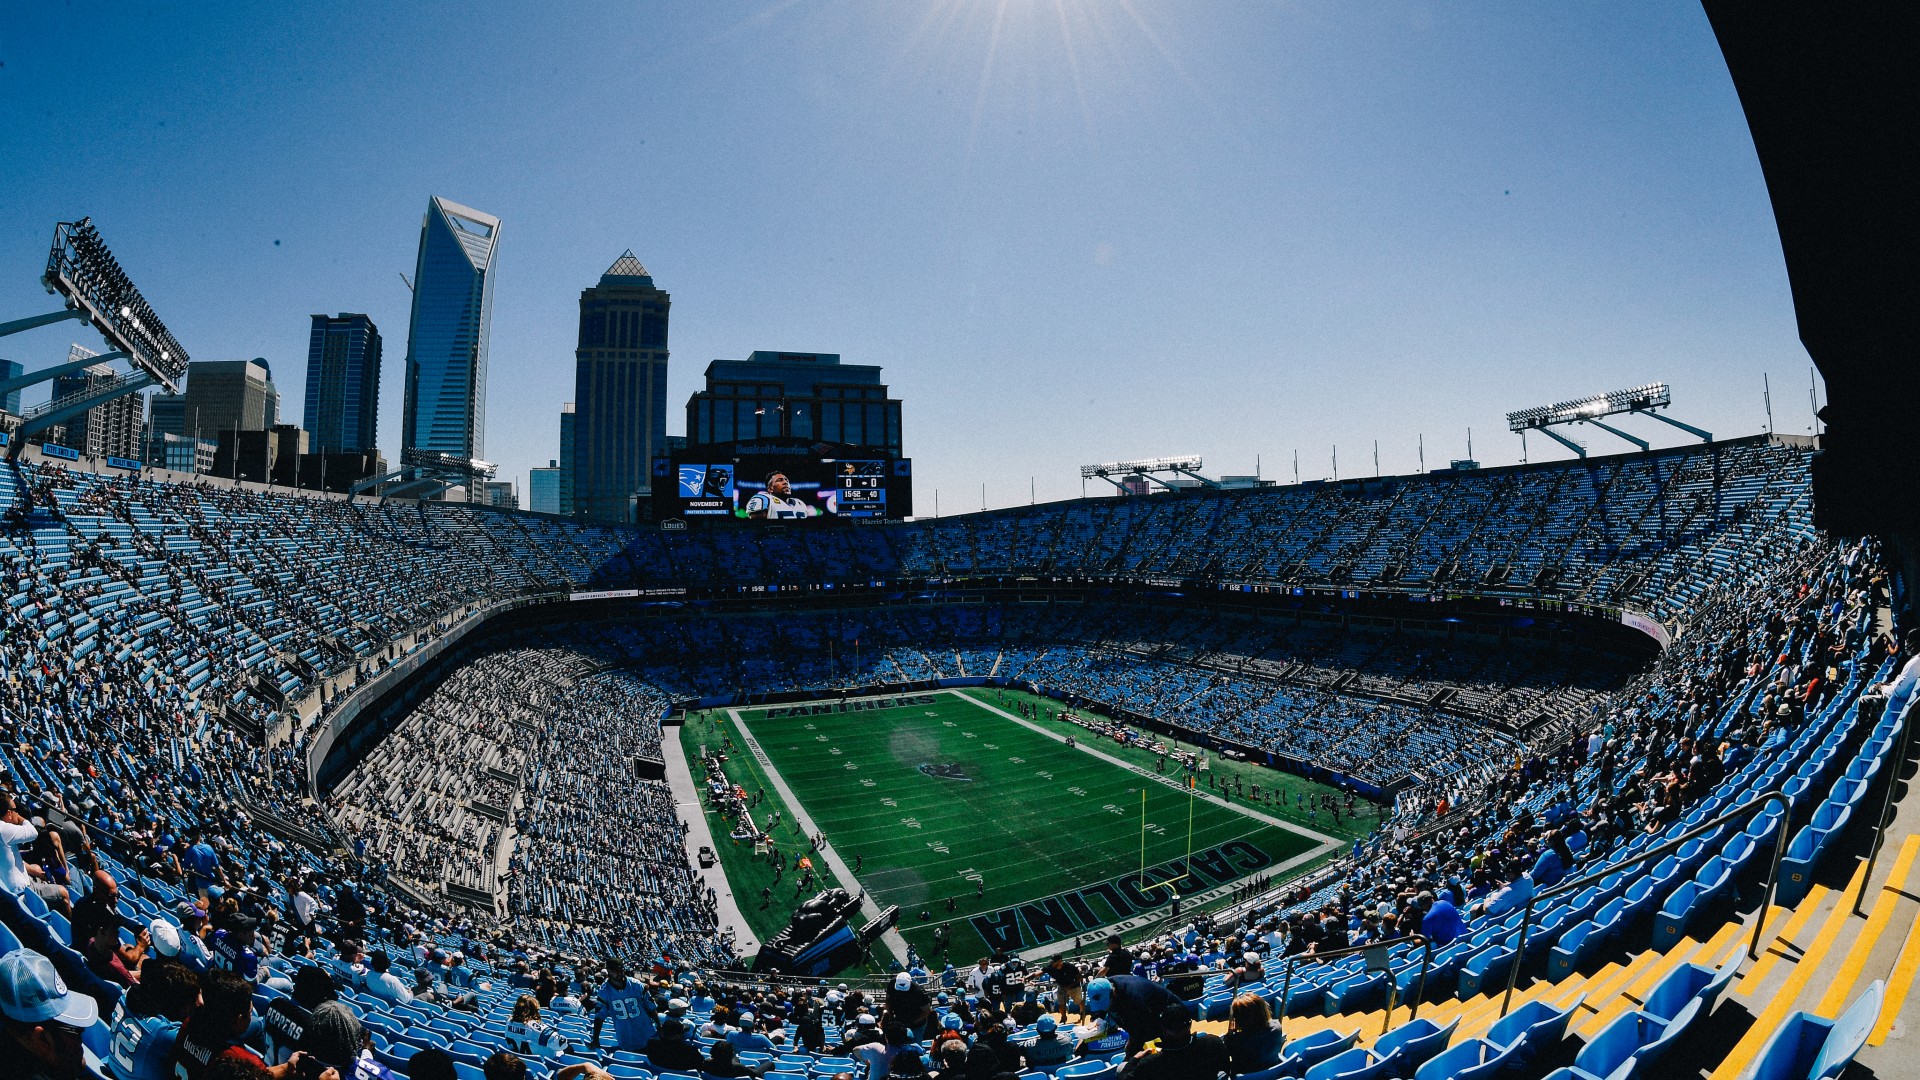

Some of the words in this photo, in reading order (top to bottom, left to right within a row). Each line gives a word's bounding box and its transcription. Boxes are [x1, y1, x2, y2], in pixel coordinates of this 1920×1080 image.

[766, 695, 937, 719] PANTHERS
[957, 867, 982, 881] 10
[1229, 881, 1245, 891] IT
[968, 841, 1271, 955] CAROLINA
[1081, 931, 1108, 943] US
[1113, 921, 1136, 934] OF
[215, 937, 237, 960] SKAGGS
[612, 997, 640, 1020] 93
[821, 1014, 836, 1026] 53
[266, 1006, 304, 1041] PEPPERS
[183, 1034, 212, 1066] GIBSON
